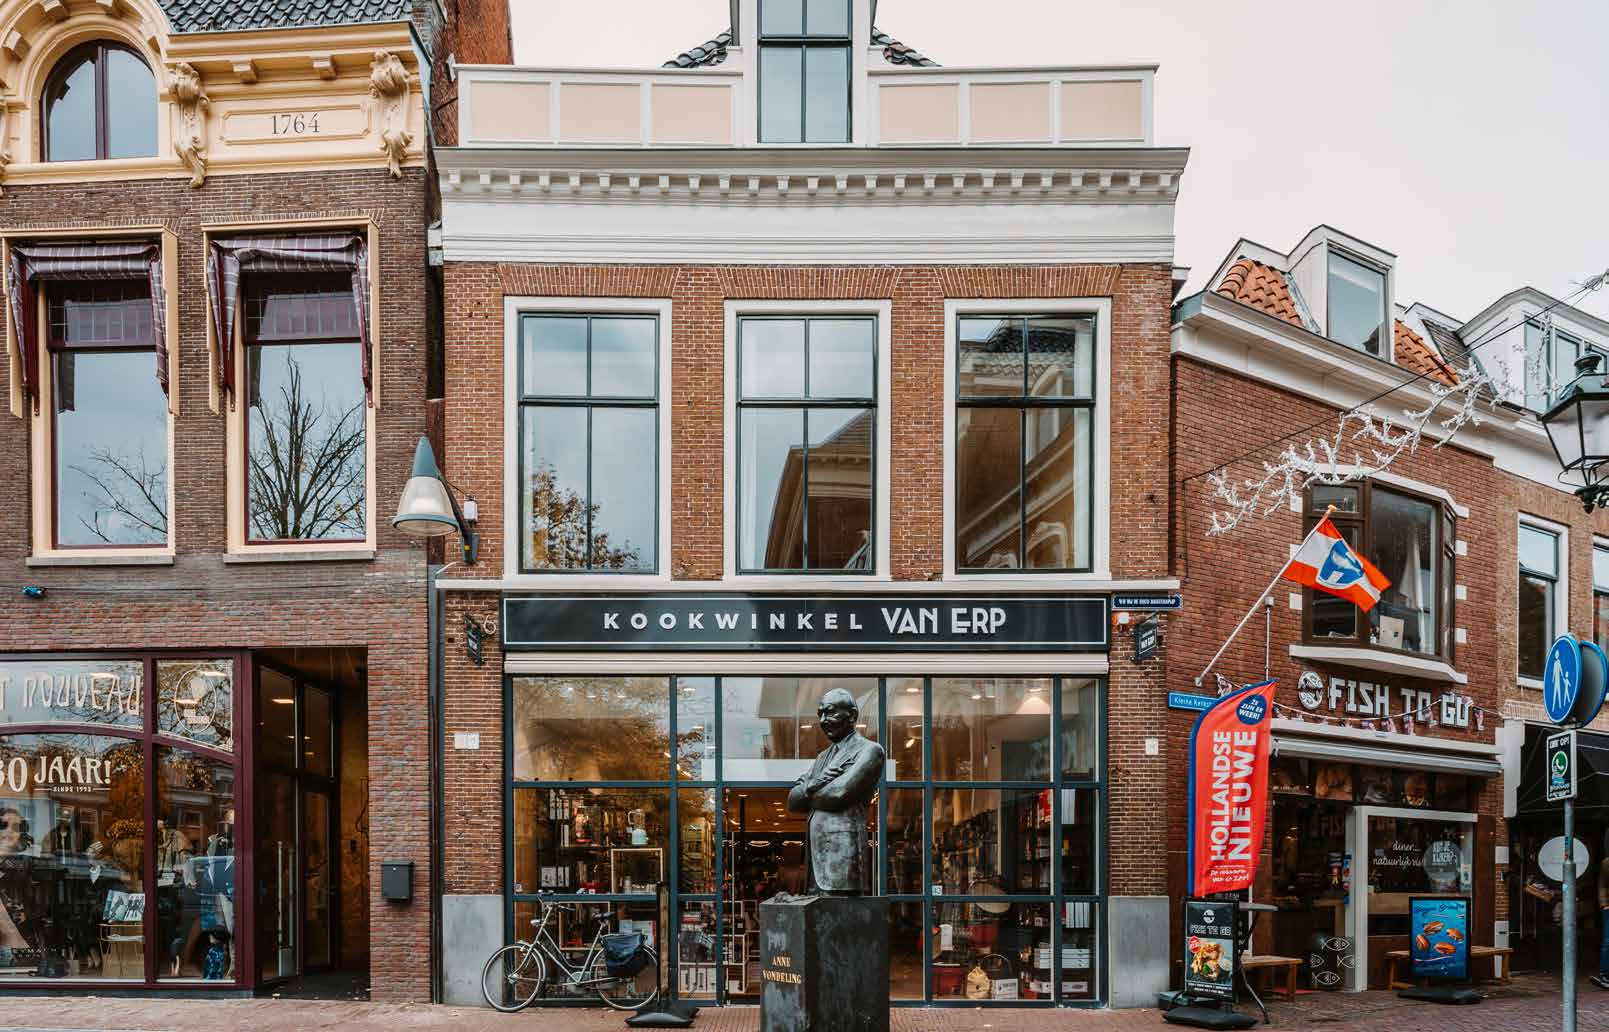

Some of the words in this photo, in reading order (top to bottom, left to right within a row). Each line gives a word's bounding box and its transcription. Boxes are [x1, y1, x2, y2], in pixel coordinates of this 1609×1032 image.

[271, 112, 320, 135] 1764
[483, 614, 497, 635] 6
[603, 612, 863, 631] KOOKWINKEL
[880, 607, 939, 635] VAN
[950, 607, 1008, 635] ERP
[23, 672, 142, 716] NOUVEAU
[1328, 674, 1391, 717] FISH
[1400, 688, 1434, 723] TO
[1440, 691, 1474, 729] GO
[1239, 708, 1261, 721] WEER!
[34, 755, 113, 785] JAAR!
[1210, 730, 1232, 861] HOLLANDSE
[1228, 730, 1257, 860] NIEUWE
[772, 955, 791, 968] ANNE
[762, 969, 802, 984] VONDELING
